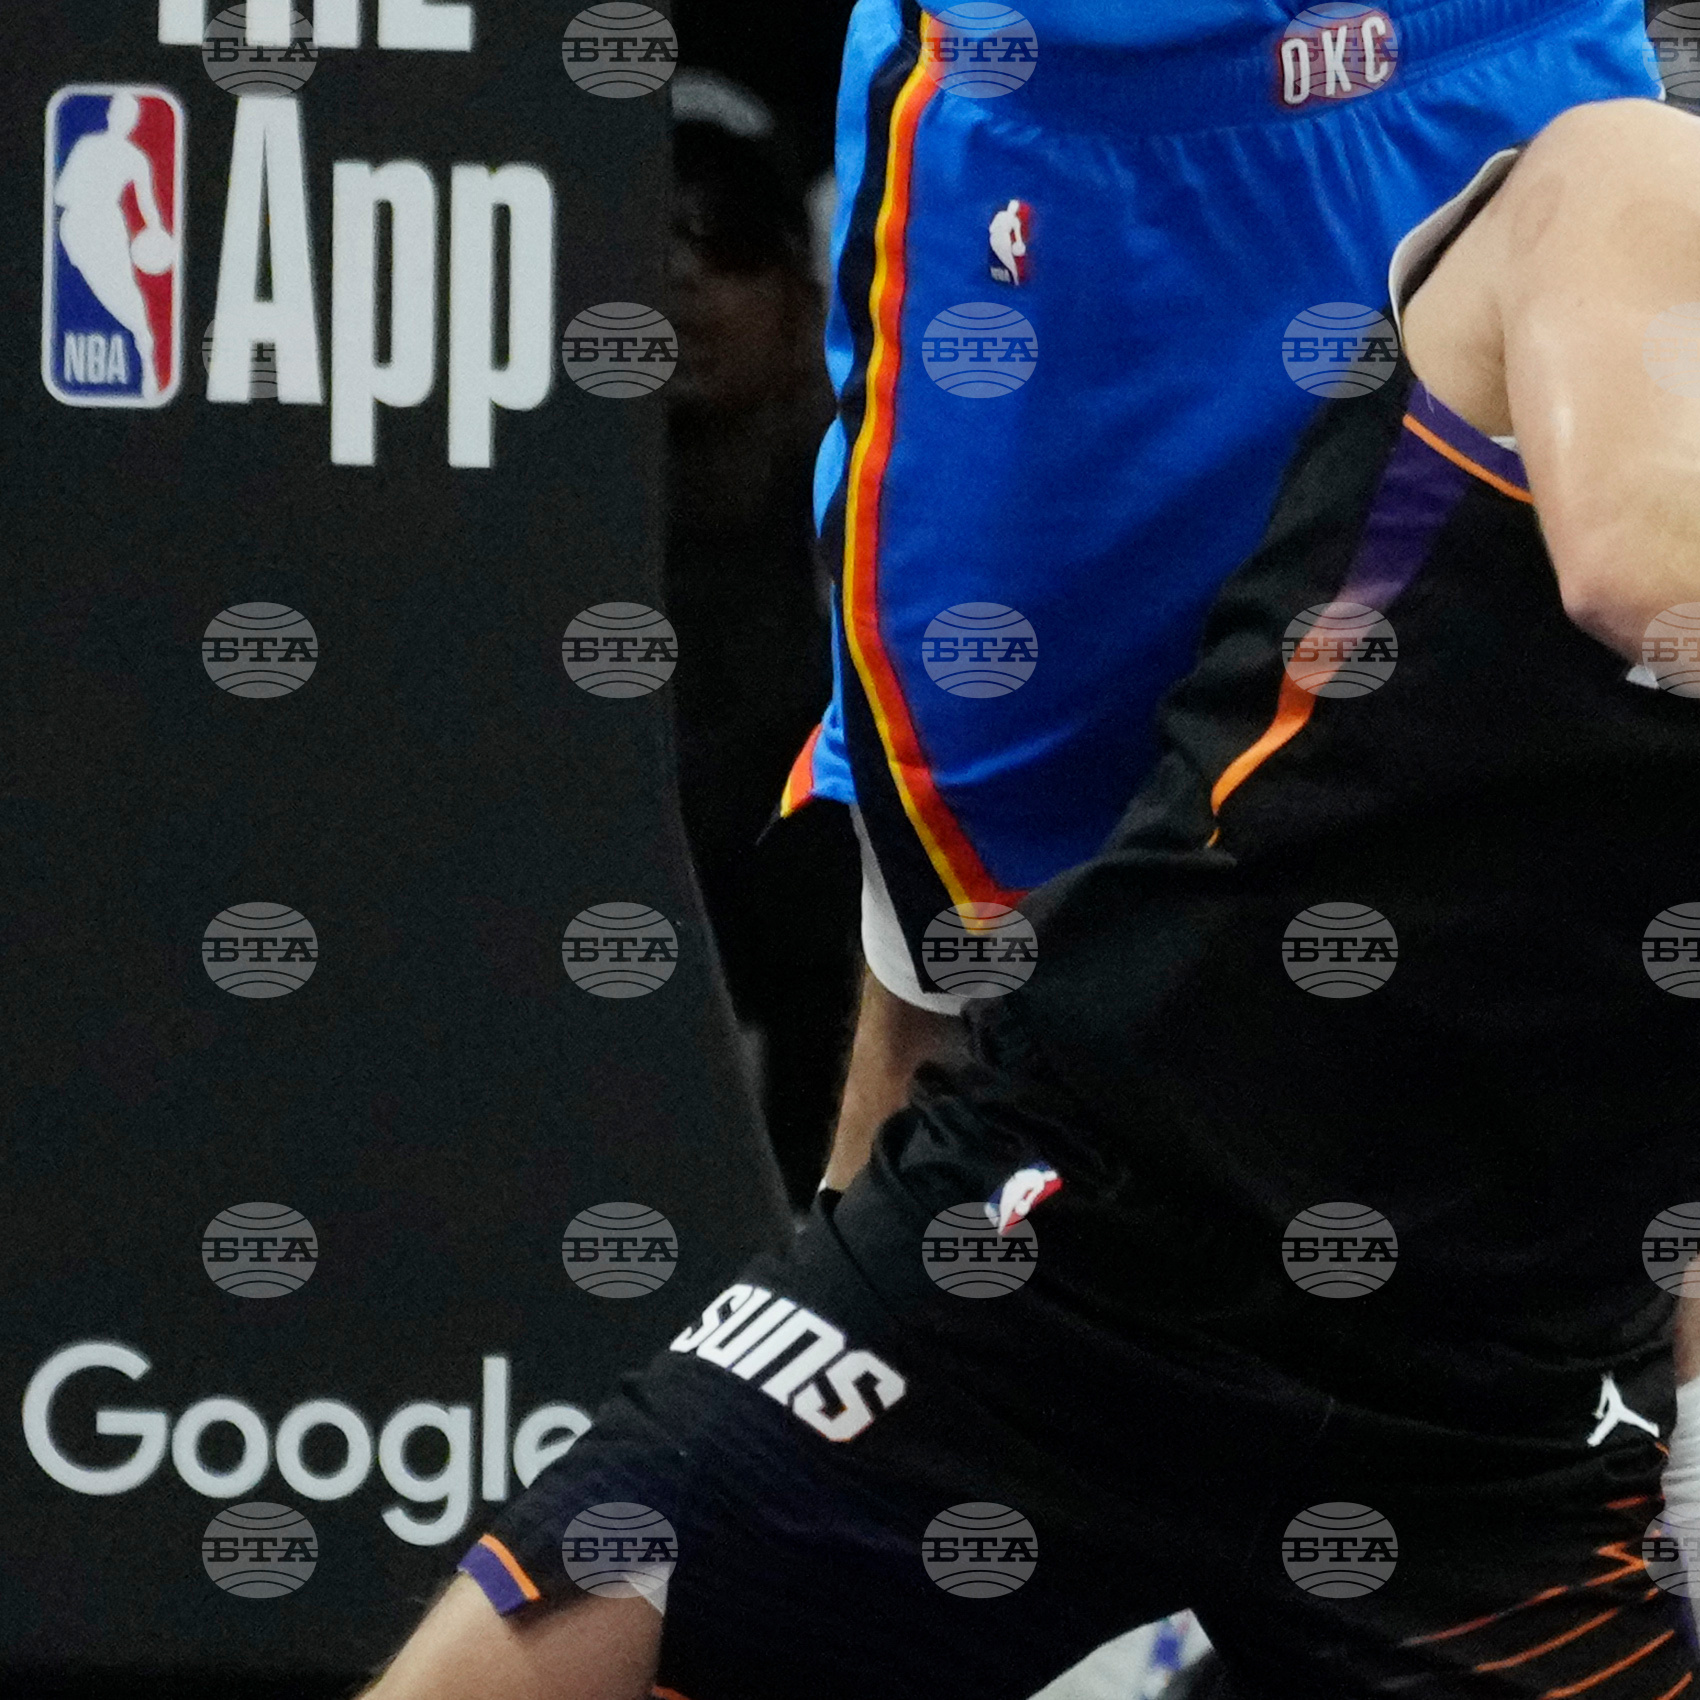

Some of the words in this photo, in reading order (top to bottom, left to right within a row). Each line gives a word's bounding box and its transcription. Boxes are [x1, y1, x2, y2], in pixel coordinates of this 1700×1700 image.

[1281, 15, 1389, 104] OKC
[205, 95, 557, 468] App
[63, 331, 129, 385] NBA
